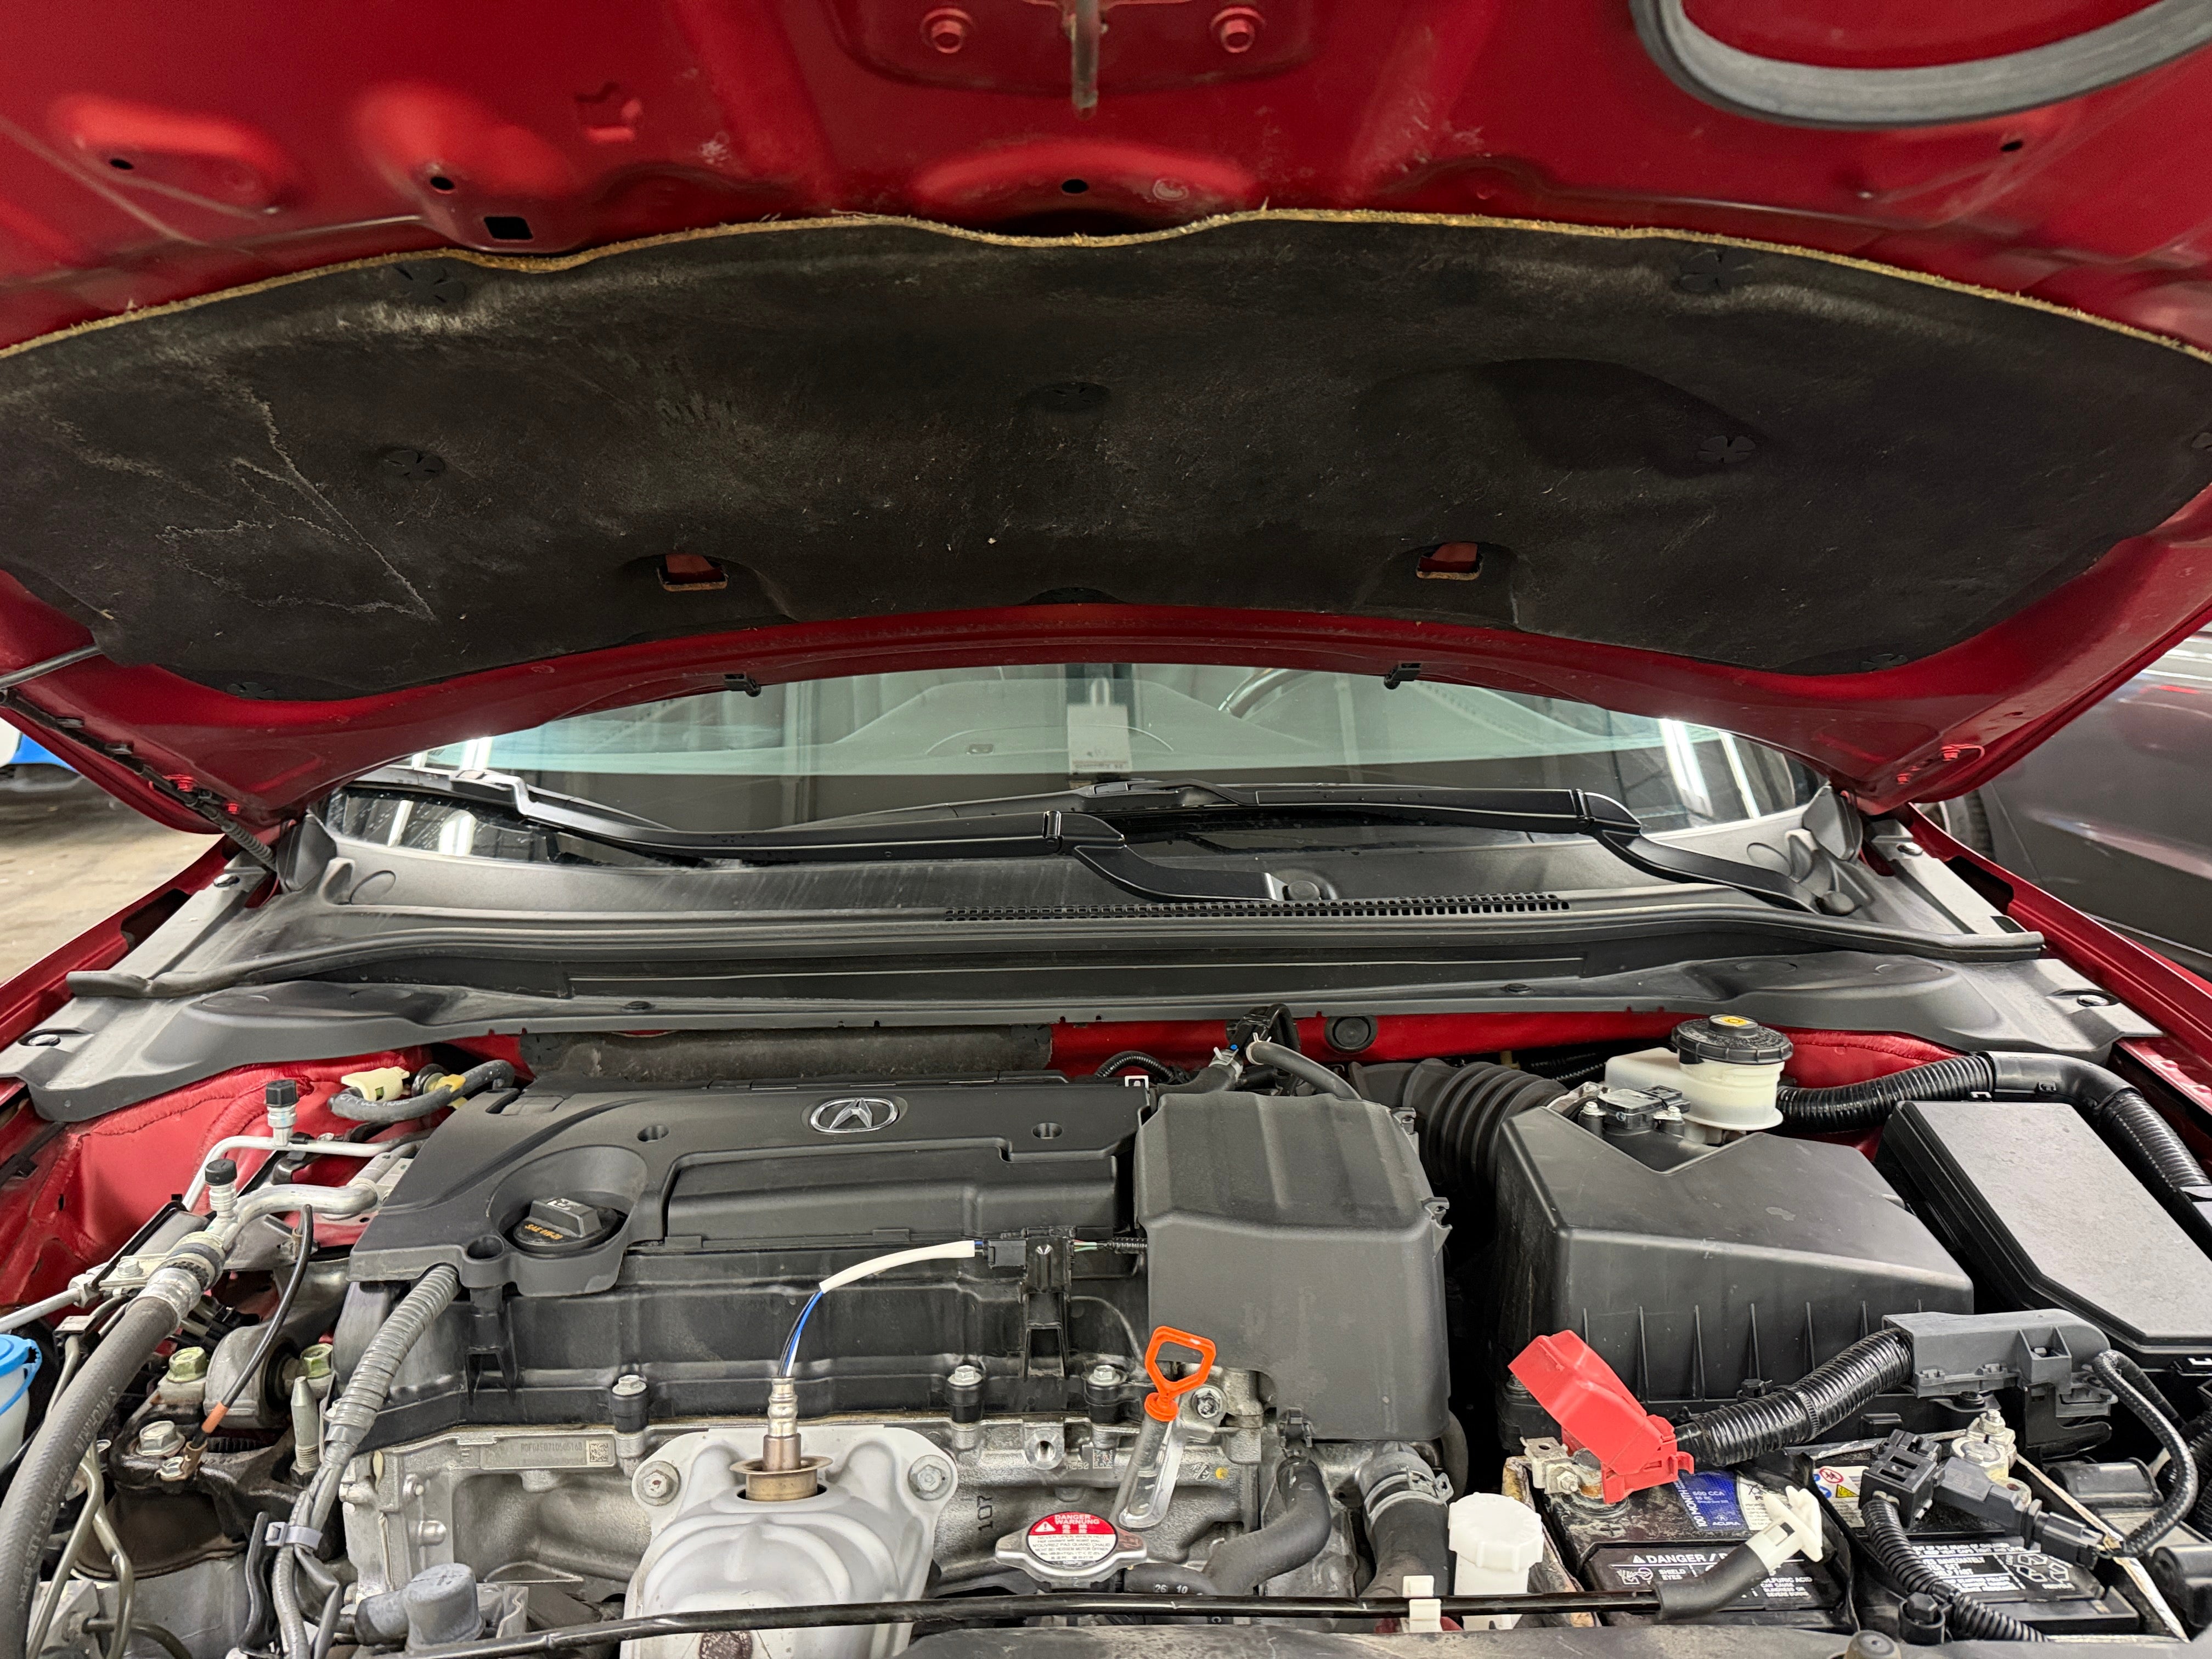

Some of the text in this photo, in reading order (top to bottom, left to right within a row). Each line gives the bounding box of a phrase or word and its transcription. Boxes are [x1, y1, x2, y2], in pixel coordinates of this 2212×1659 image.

[1678, 1489, 1701, 1516] MONTH
[1694, 1515, 1708, 1527] 100
[1646, 1554, 1706, 1564] DANGER
[1154, 1584, 1189, 1594] 26 10
